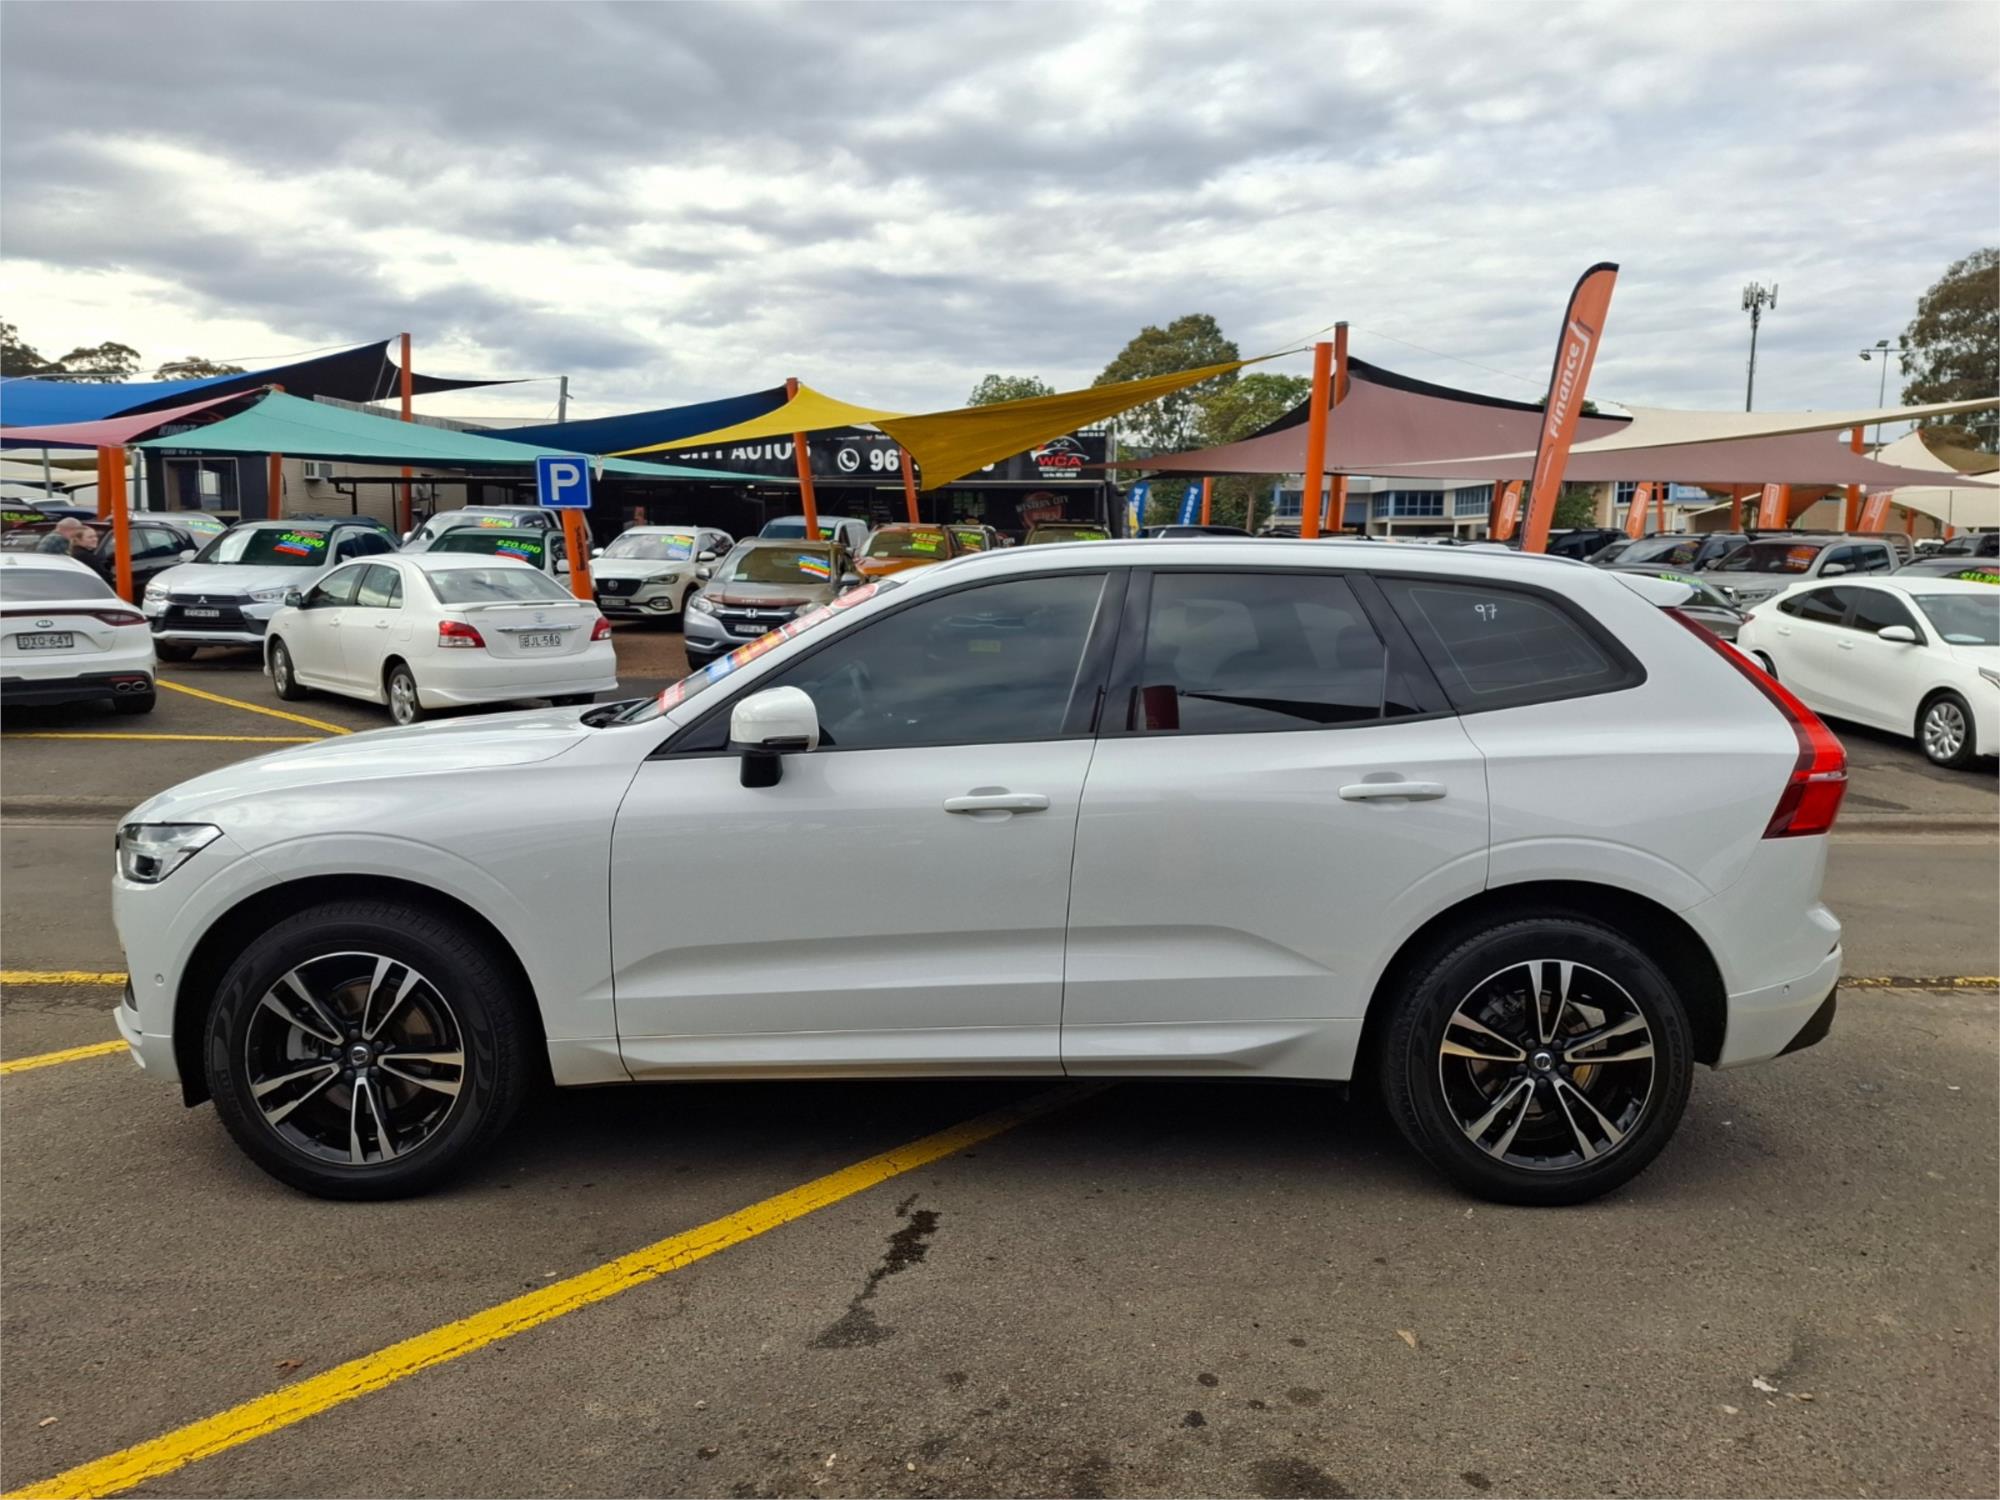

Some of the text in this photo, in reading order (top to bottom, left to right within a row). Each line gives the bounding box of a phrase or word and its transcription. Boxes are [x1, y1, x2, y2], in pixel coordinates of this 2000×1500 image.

[1550, 342, 1580, 439] Finance
[1039, 455, 1082, 467] WCA
[549, 463, 580, 501] P
[1474, 603, 1498, 621] 97
